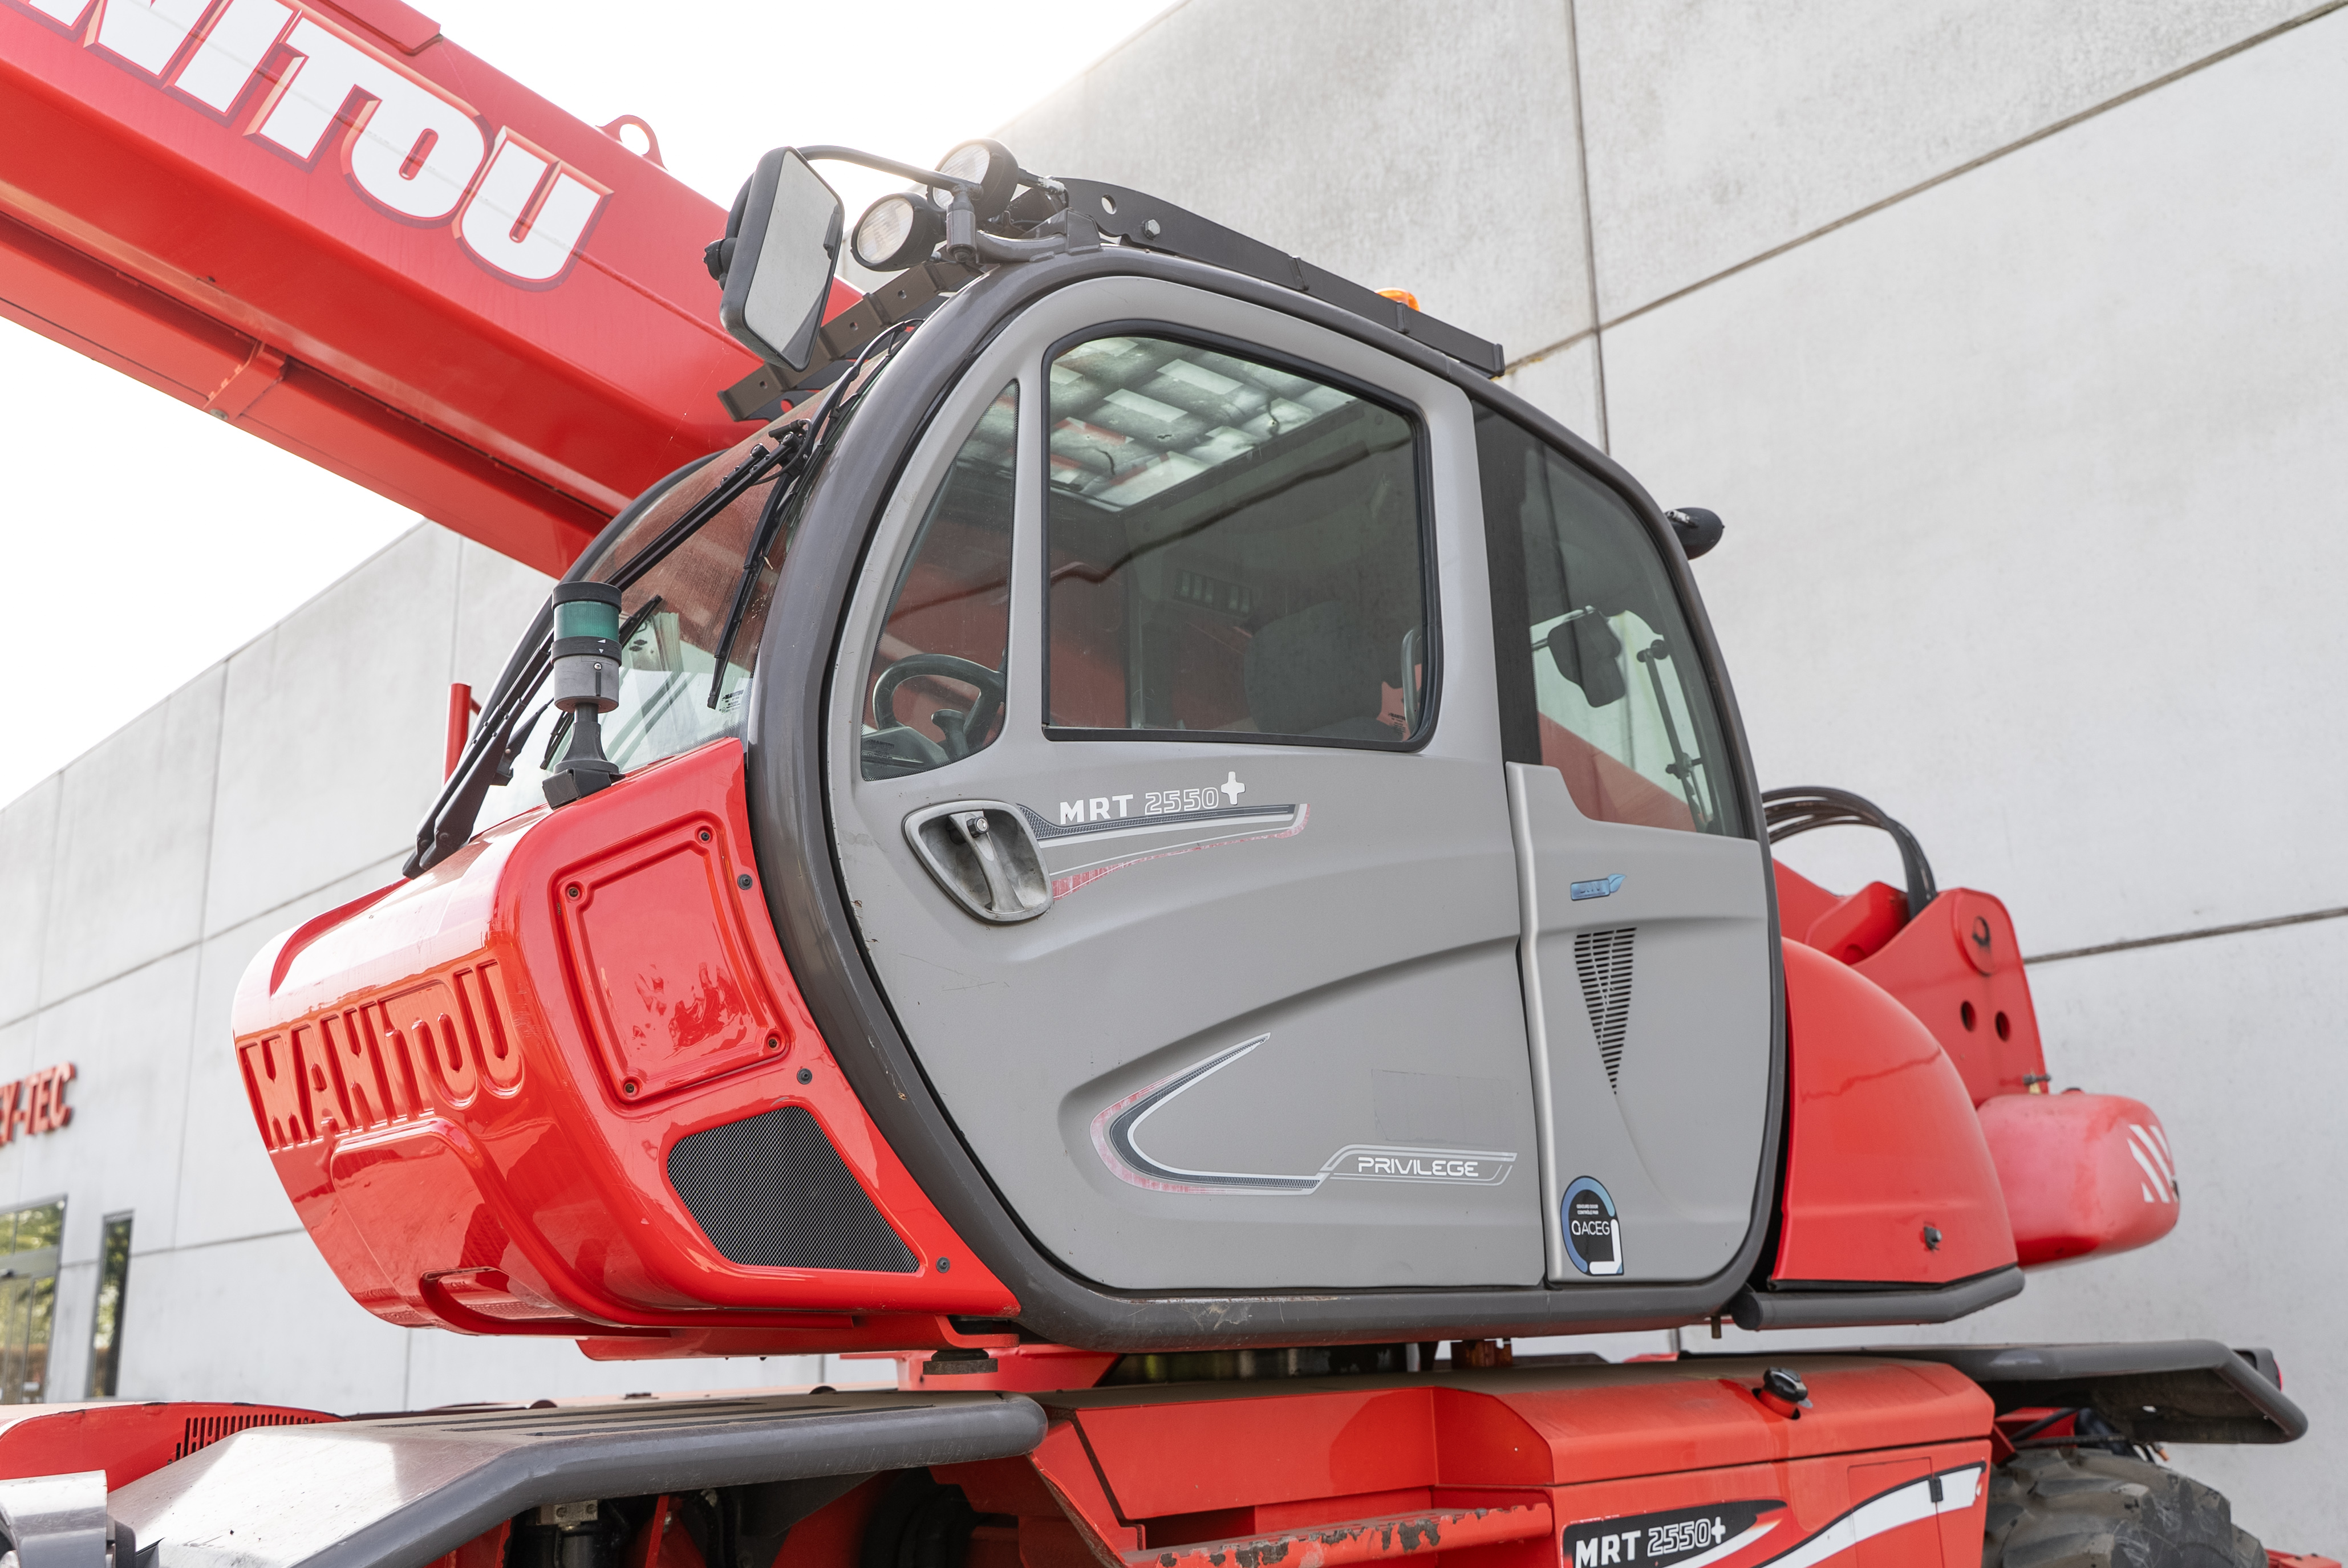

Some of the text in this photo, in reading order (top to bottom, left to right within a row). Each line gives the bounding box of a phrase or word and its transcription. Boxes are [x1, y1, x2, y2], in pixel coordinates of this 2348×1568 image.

[1059, 794, 1134, 825] MRT
[240, 959, 524, 1153] MANITOU
[1358, 1156, 1479, 1177] PRIVILEGE
[1575, 1516, 1726, 1568] MRT 2550+
